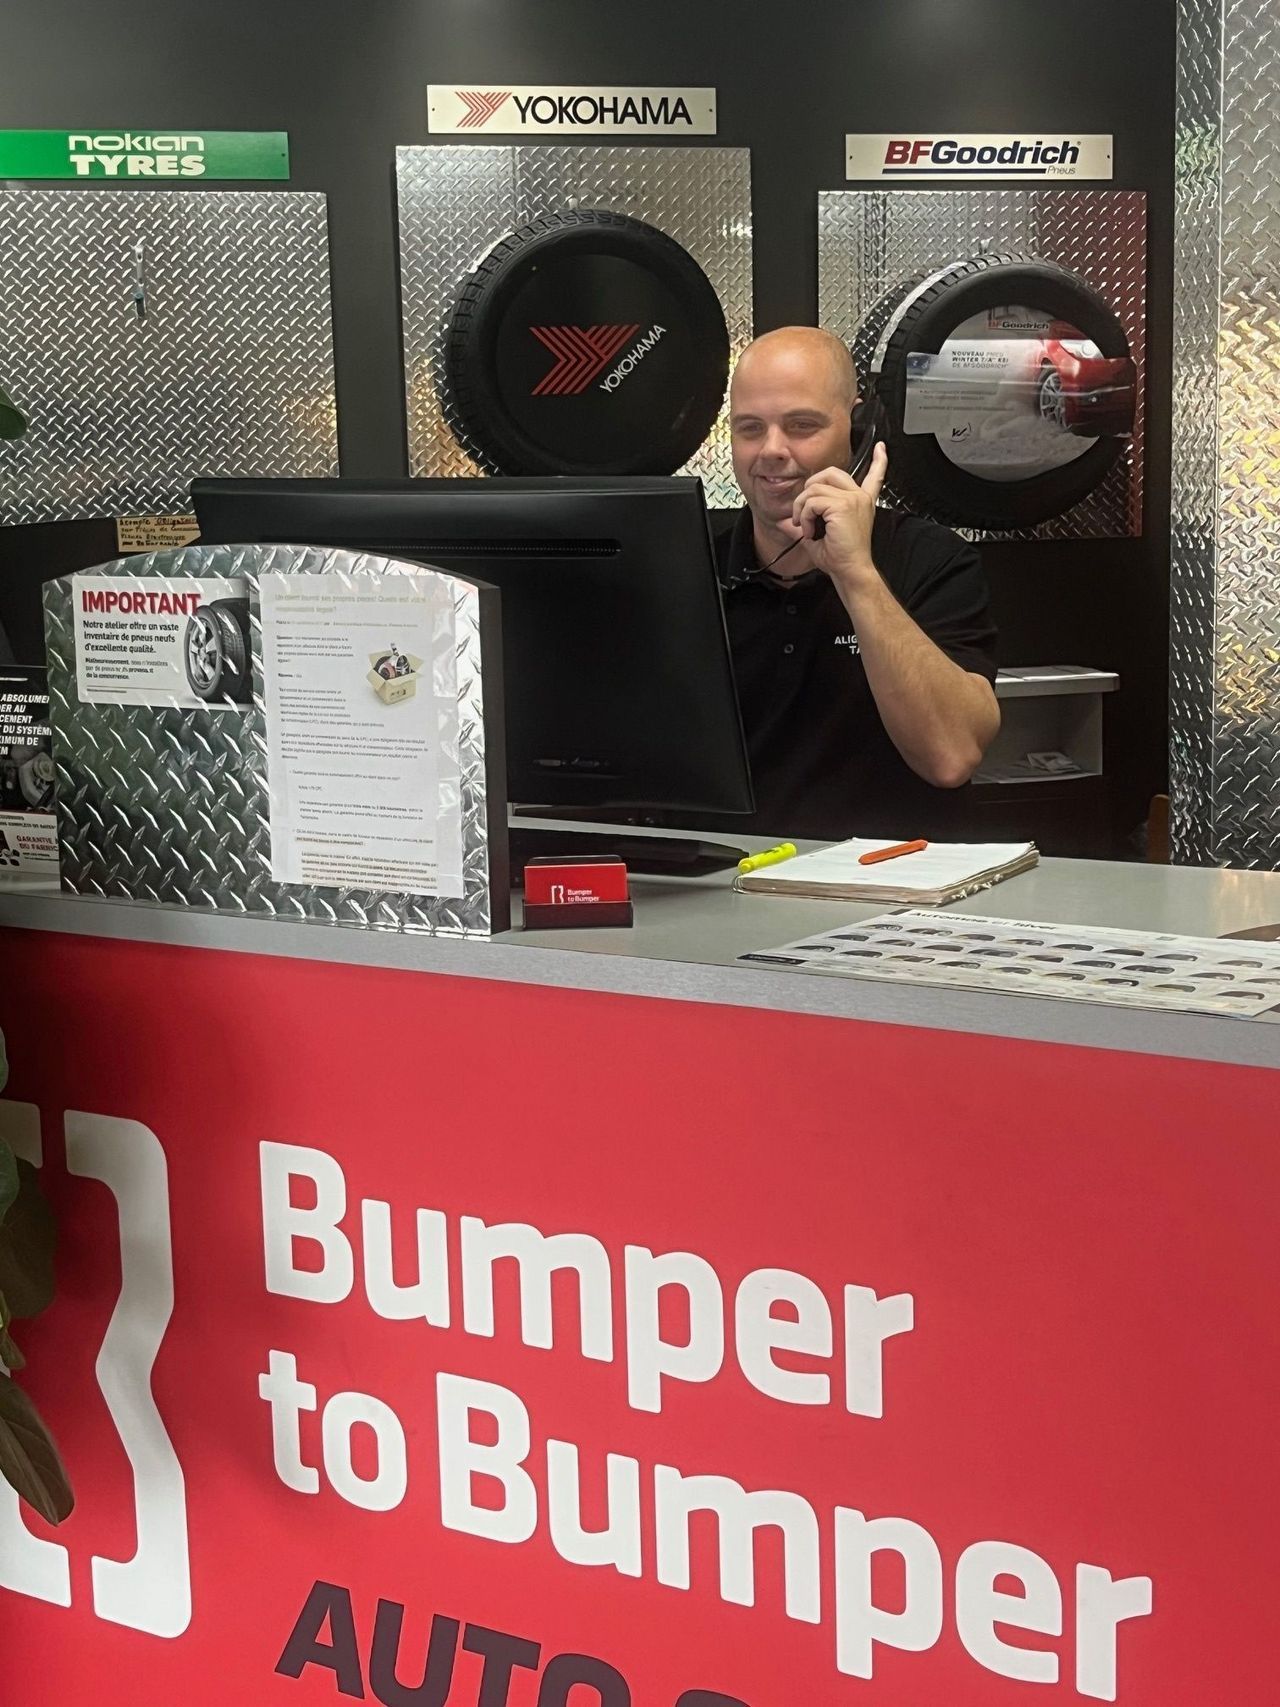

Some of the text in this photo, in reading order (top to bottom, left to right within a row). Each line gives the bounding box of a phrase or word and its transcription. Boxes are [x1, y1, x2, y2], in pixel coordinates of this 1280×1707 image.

[512, 95, 693, 125] YOKOHAMA
[69, 154, 206, 176] TYRES
[1047, 165, 1076, 175] Pneus
[600, 324, 667, 393] YOKOHAMA
[82, 590, 202, 615] IMPORTANT
[83, 620, 179, 632] Notre atelier offre un vaste
[121, 632, 130, 641] de
[131, 633, 153, 643] pneus
[154, 632, 176, 643] neufs
[85, 642, 128, 652] d'excellente
[14, 704, 26, 713] AU
[3, 725, 15, 734] DU
[27, 737, 39, 746] DE
[258, 1140, 914, 1419] Bumper
[258, 1349, 1153, 1702] to Bumper
